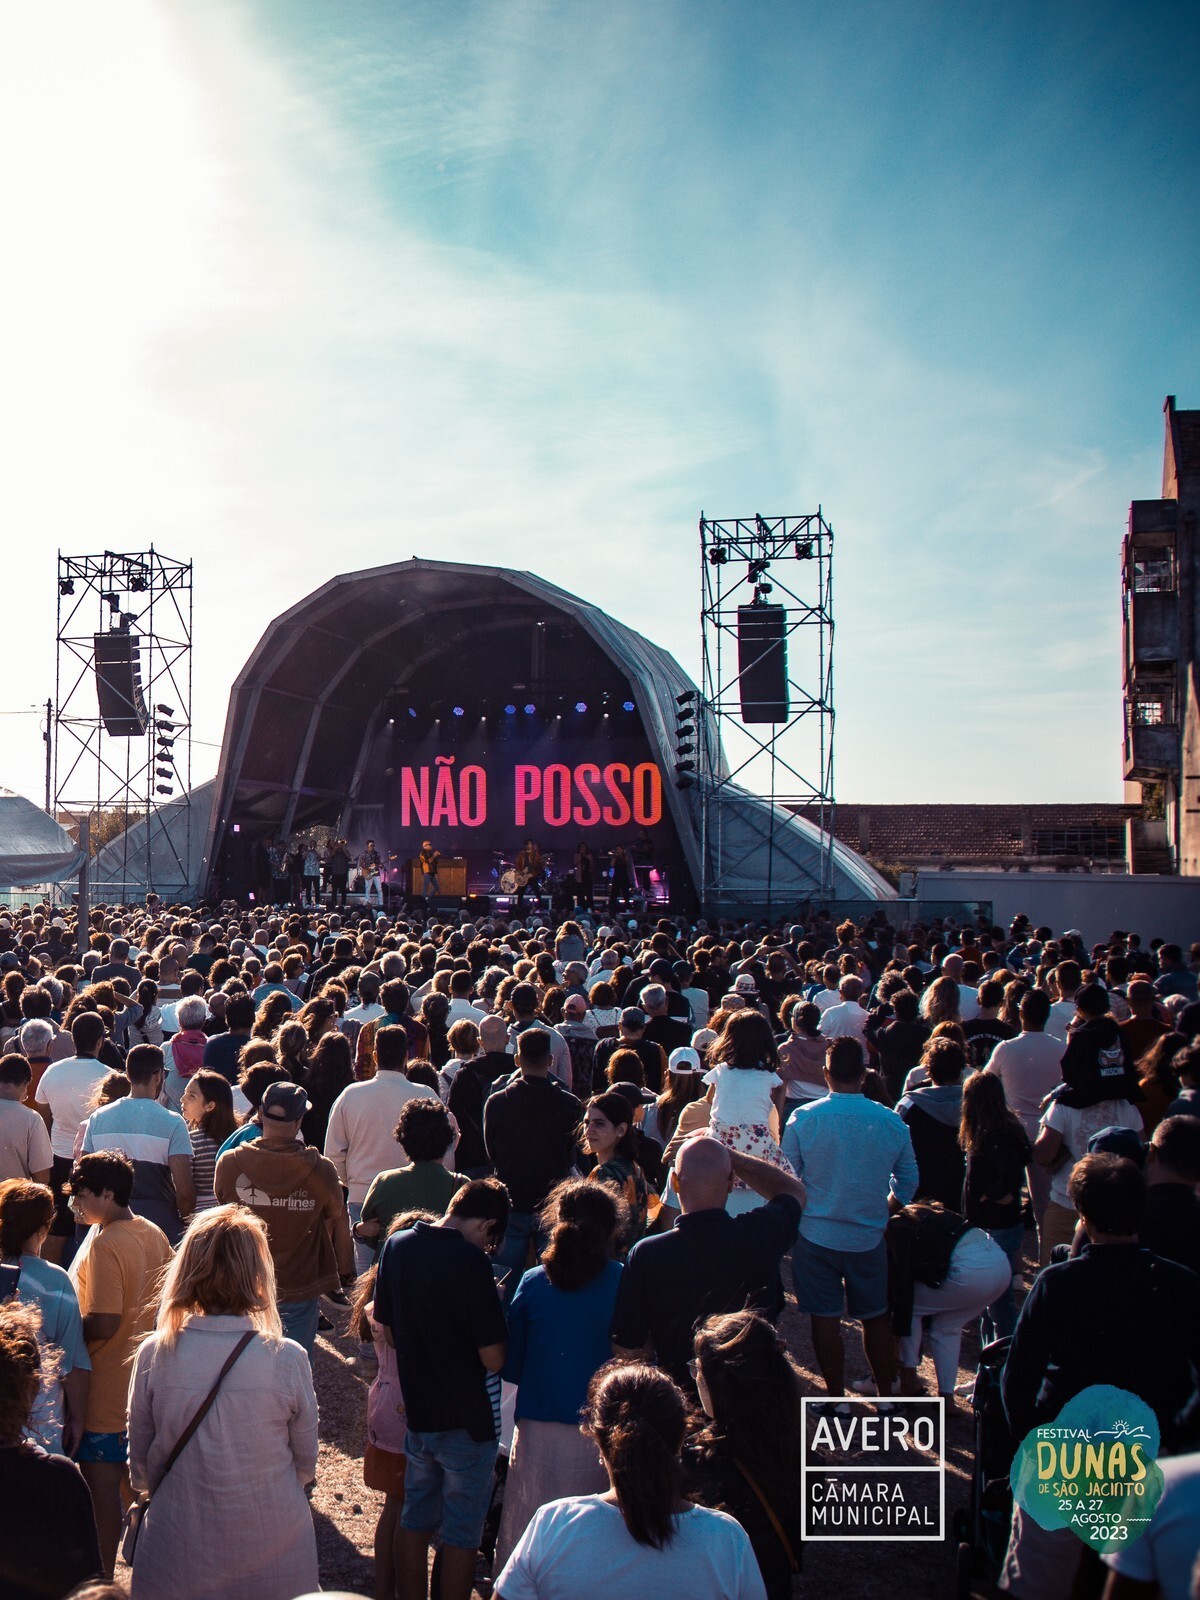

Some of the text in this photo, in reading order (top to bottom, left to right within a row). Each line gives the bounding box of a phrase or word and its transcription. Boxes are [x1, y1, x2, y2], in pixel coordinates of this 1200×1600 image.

[401, 755, 662, 827] NÃO POSSO
[272, 1196, 316, 1207] airlines
